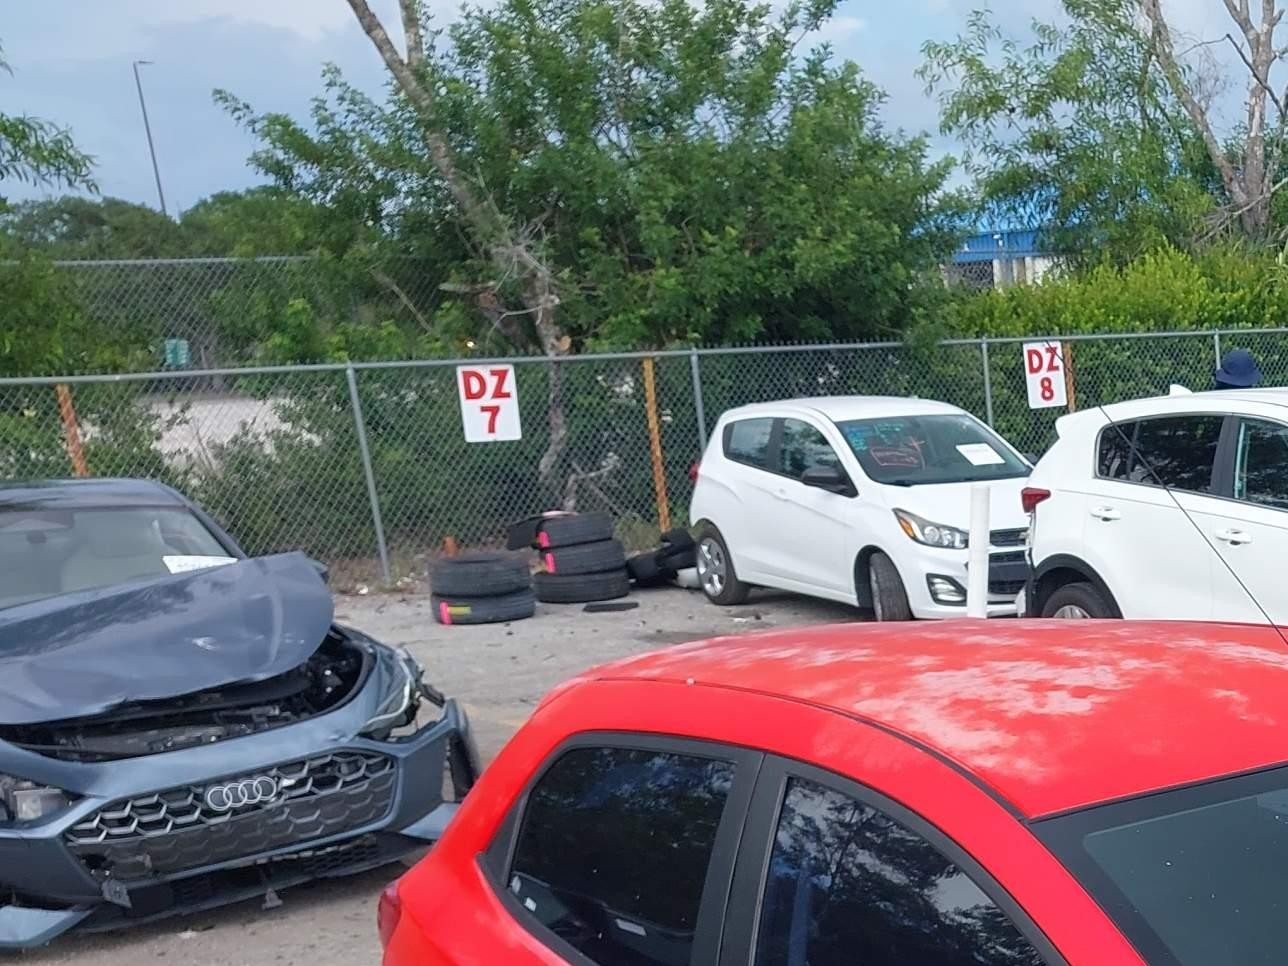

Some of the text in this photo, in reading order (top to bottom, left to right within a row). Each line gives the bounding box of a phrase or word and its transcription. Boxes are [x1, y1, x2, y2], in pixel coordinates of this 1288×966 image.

[1027, 346, 1060, 375] DZ
[462, 368, 511, 400] DZ
[1040, 377, 1055, 401] 8
[480, 405, 500, 434] 7
